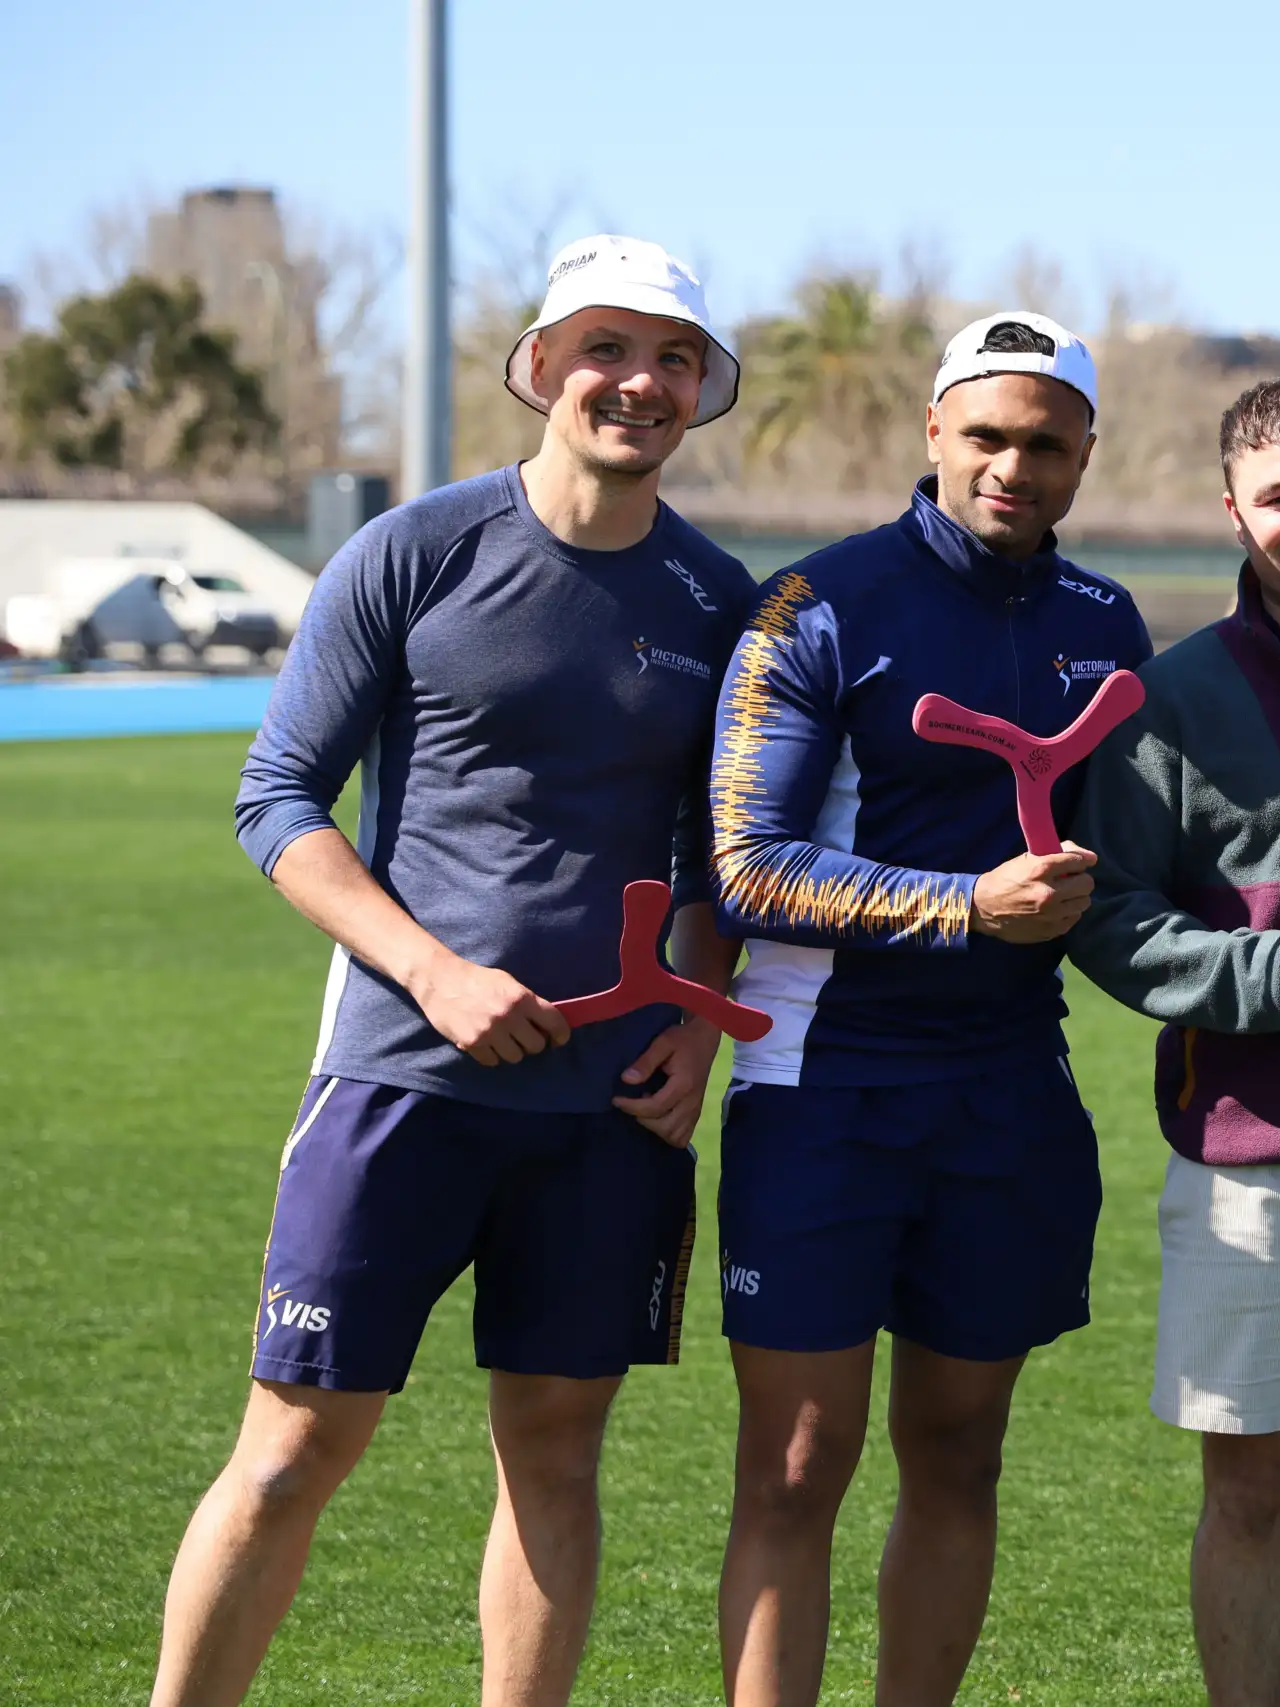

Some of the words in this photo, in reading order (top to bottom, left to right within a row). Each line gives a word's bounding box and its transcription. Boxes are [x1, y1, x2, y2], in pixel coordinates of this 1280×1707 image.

[664, 559, 718, 611] 2XU
[1057, 575, 1116, 605] 2XU
[650, 647, 711, 675] VICTORIAN
[1070, 660, 1116, 673] VICTORIAN
[928, 720, 1017, 751] BOOMERLEARN.COM.AU
[730, 1264, 760, 1295] VIS
[281, 1299, 331, 1332] VIS
